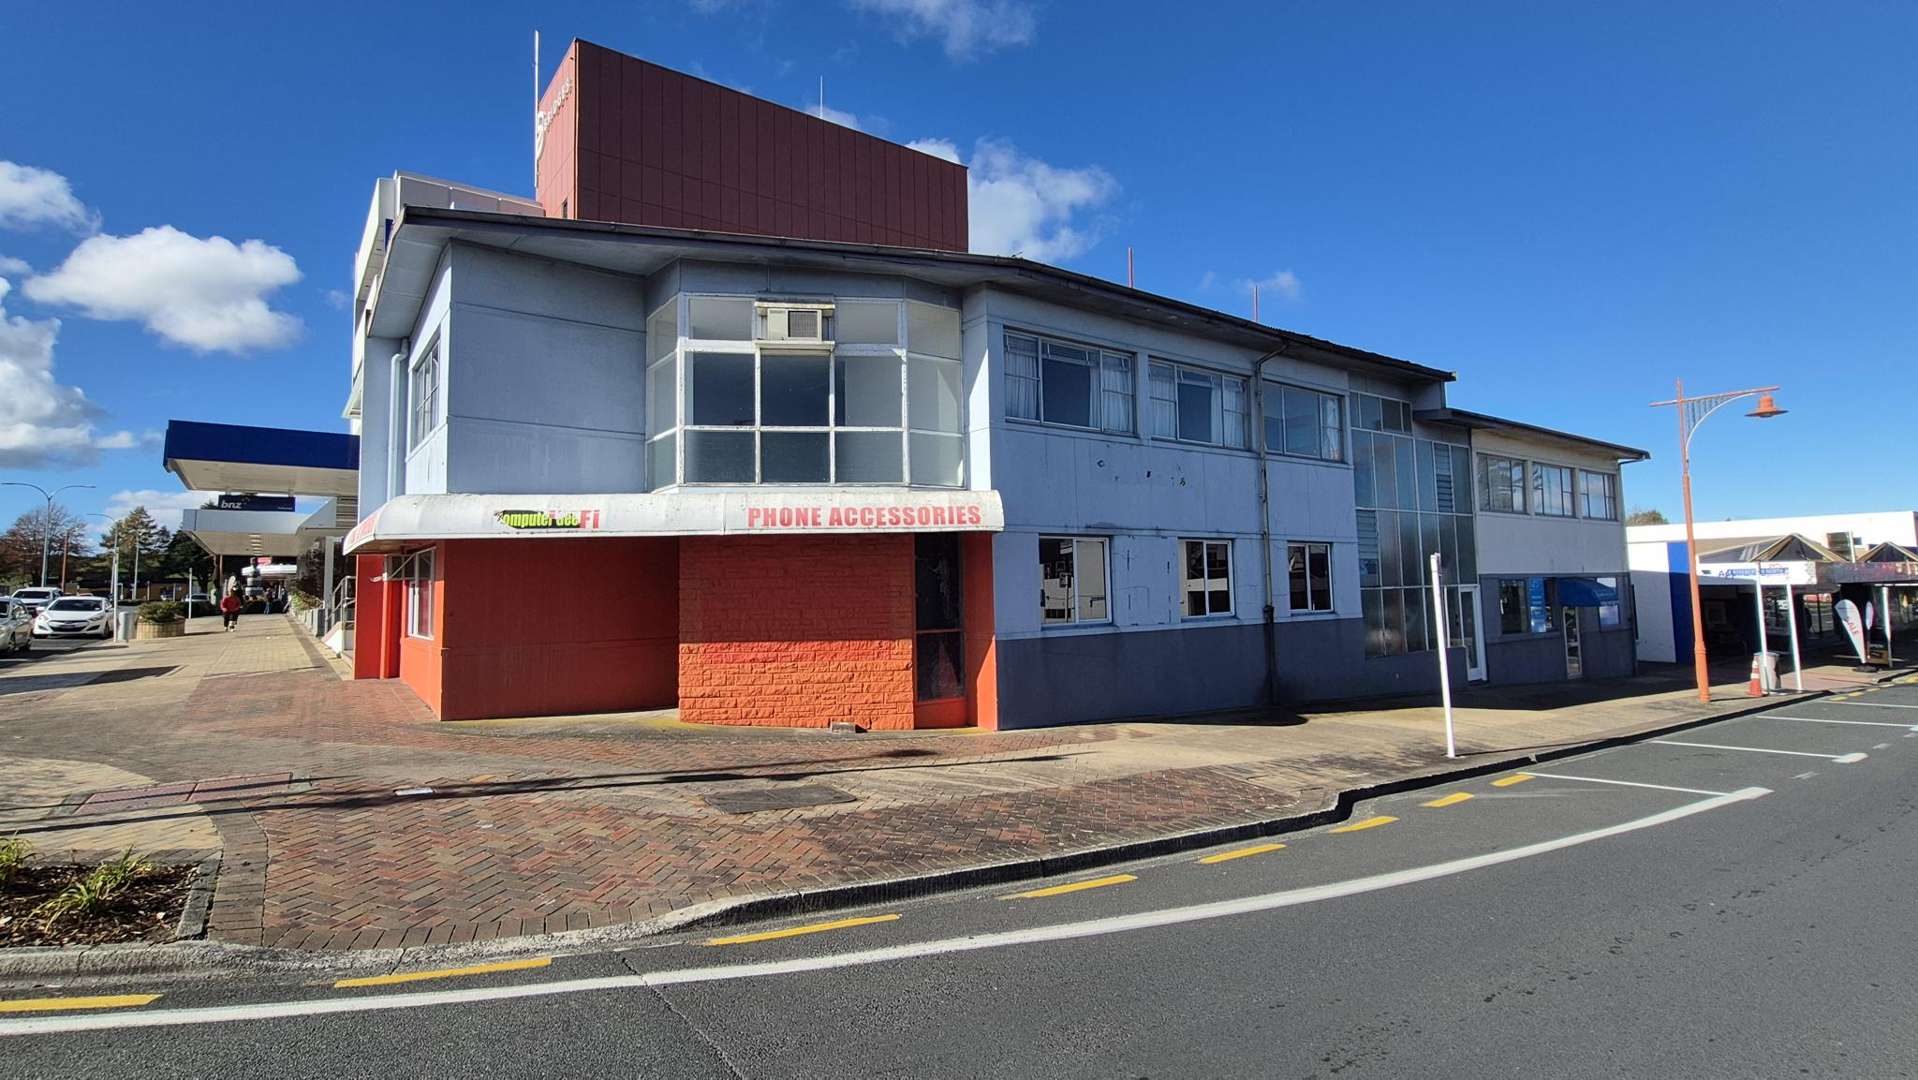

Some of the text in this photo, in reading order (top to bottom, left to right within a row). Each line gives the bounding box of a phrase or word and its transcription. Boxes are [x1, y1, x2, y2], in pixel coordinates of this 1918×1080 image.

[221, 499, 242, 509] bnz
[747, 505, 982, 528] PHONE ACCESSORIES
